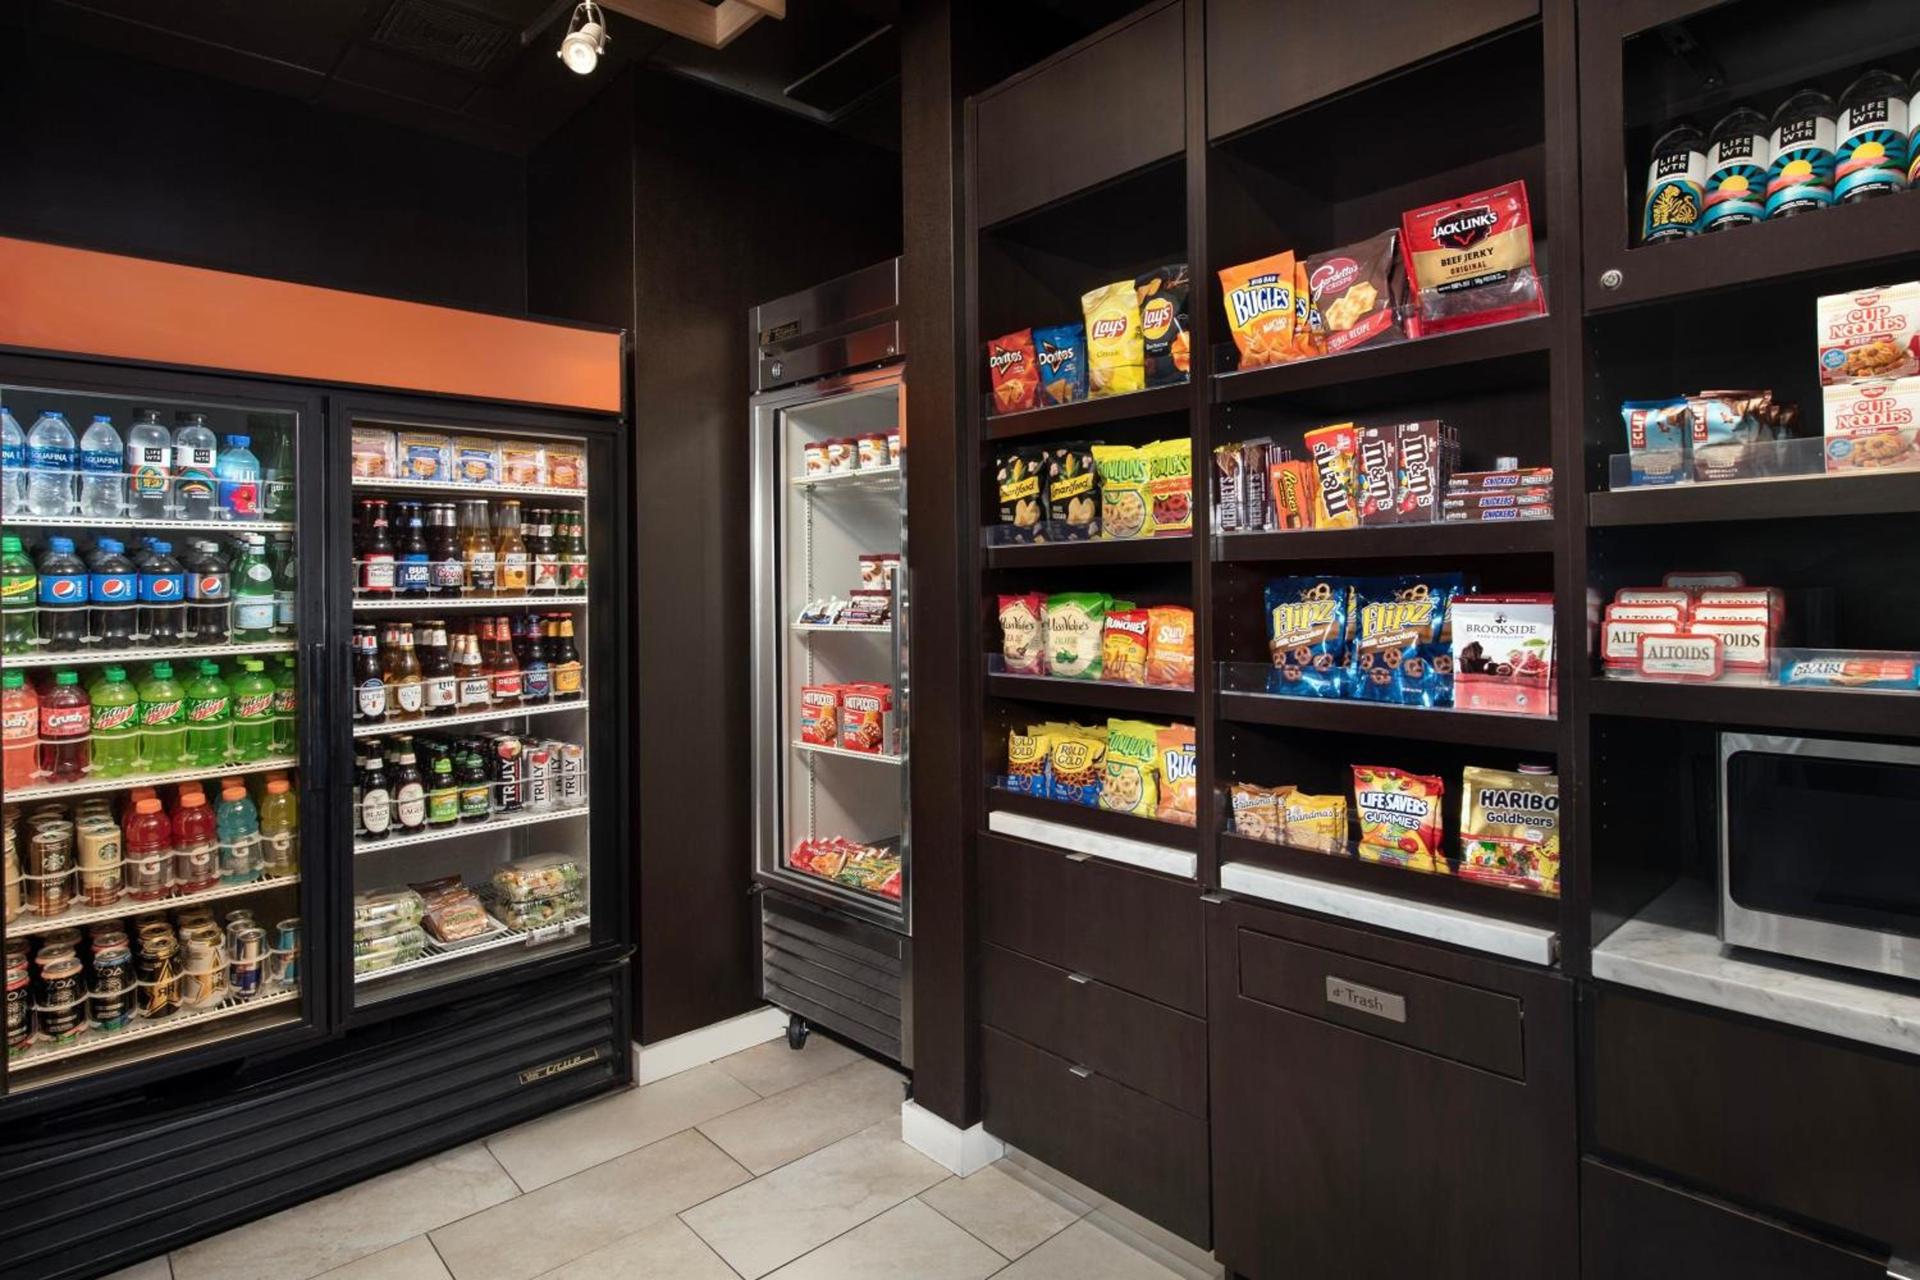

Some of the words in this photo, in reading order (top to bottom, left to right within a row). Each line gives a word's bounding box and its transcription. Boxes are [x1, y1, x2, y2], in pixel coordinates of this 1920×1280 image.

[1852, 100, 1884, 115] LIFE
[1852, 110, 1885, 125] WTR
[1783, 121, 1813, 134] LIFE
[1722, 138, 1751, 149] LIFE
[1782, 130, 1812, 143] WTR
[1661, 154, 1687, 166] LIFE
[1721, 146, 1750, 158] WTR
[1659, 163, 1685, 174] WTR
[1432, 222, 1460, 239] JACK
[1441, 255, 1462, 267] BEEF
[1463, 247, 1494, 262] JERKY
[1450, 261, 1487, 275] ORIGINAL
[1231, 287, 1289, 328] BUGLES
[1847, 306, 1891, 324] CUP
[1829, 315, 1907, 339] NOODLES
[990, 351, 1022, 368] Doritos
[1039, 347, 1074, 366] Doritos
[1853, 398, 1896, 415] CUP
[1836, 408, 1912, 430] NOODLES
[1485, 476, 1518, 486] SNICKERS
[1483, 510, 1516, 520] SNICKERS
[408, 566, 428, 574] BUD
[1379, 631, 1419, 644] Chocolate
[1466, 624, 1537, 635] BROOKSIDE
[1648, 645, 1710, 661] ALTOIDS
[48, 712, 83, 728] Crush
[1061, 744, 1084, 756] ROLD
[1057, 754, 1083, 766] GOLD
[1166, 750, 1196, 783] BUG
[502, 759, 515, 804] TRULY
[534, 765, 545, 801] TRULY
[565, 759, 575, 797] TRULY
[1360, 792, 1385, 808] LIFE
[1386, 793, 1427, 816] SAVERS
[1480, 788, 1559, 812] HARIBO
[1364, 811, 1420, 831] GUMMIES
[1486, 812, 1553, 827] Goldbears
[1345, 987, 1384, 1012] Trash
